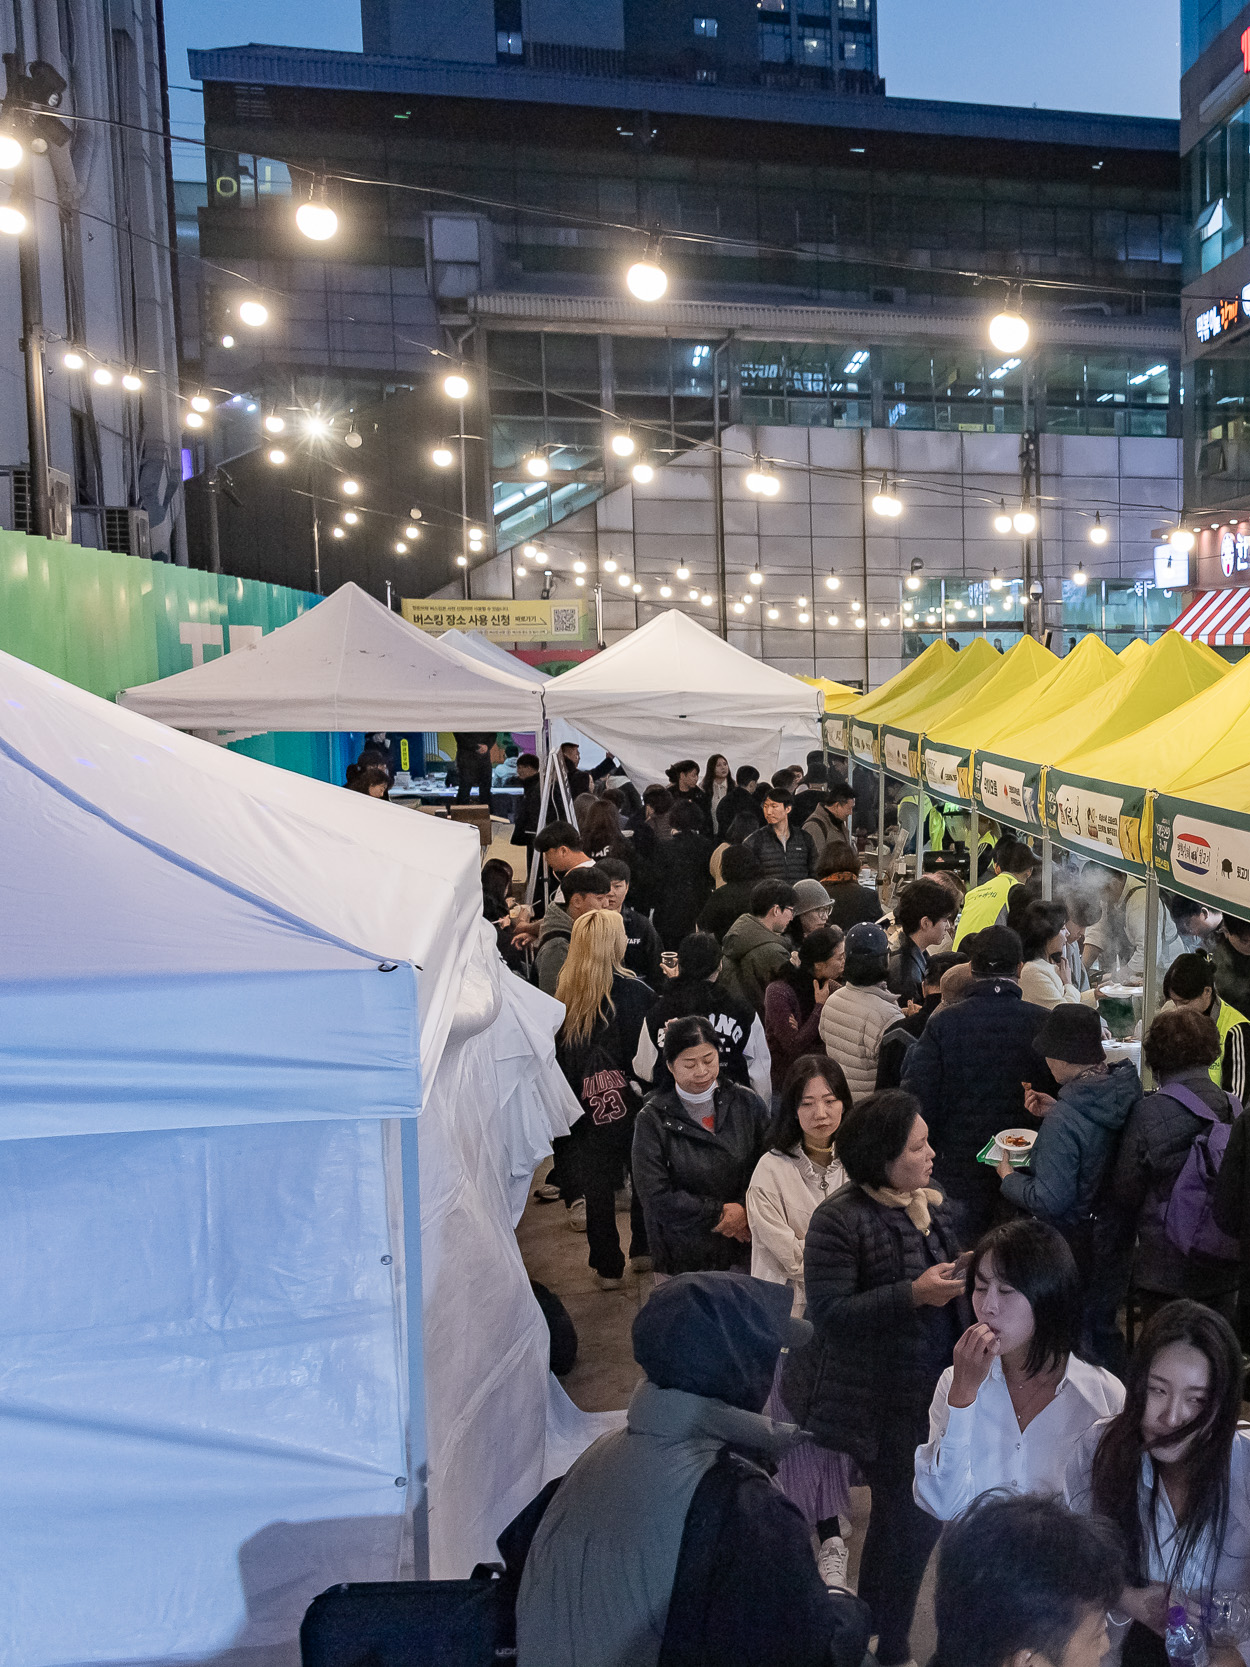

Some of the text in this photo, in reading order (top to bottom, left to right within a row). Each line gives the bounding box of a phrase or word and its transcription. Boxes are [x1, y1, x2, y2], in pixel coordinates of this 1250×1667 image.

[413, 614, 444, 626] 버스킹
[446, 614, 466, 626] 장소
[468, 614, 488, 626] 사용
[491, 614, 510, 626] 신청
[590, 1089, 627, 1125] 23
